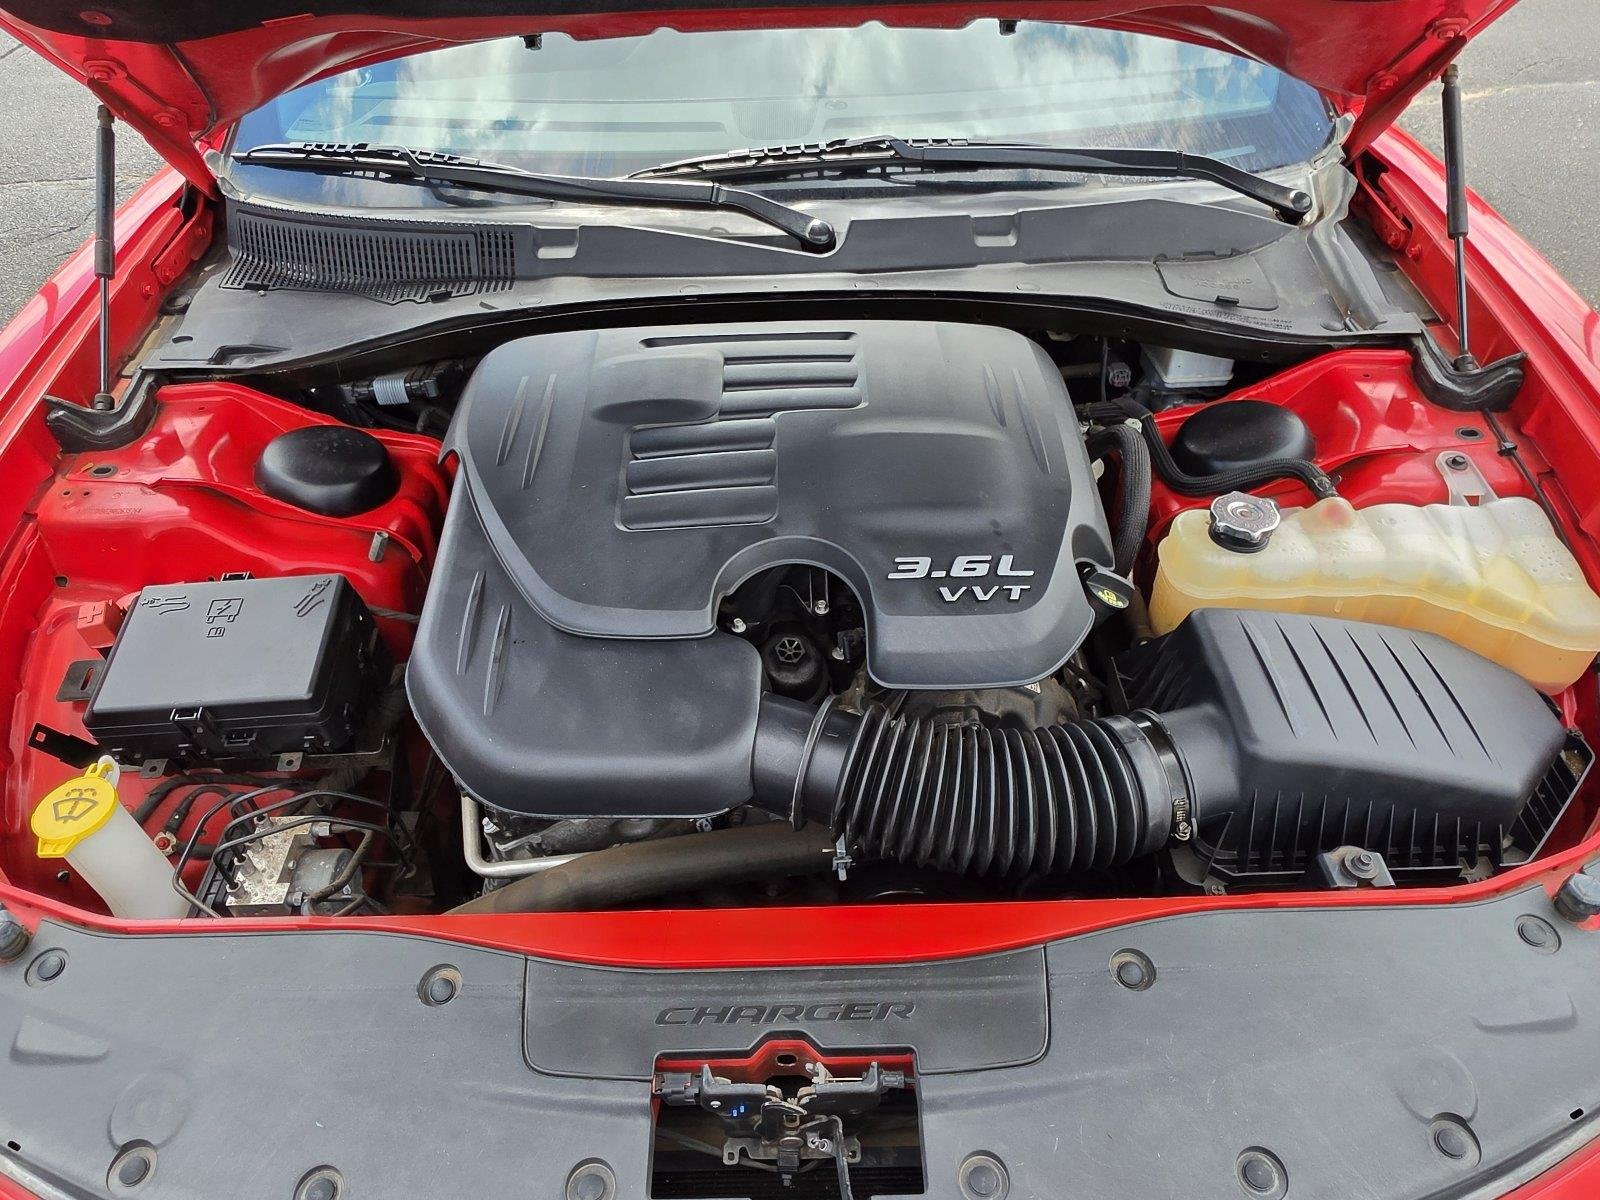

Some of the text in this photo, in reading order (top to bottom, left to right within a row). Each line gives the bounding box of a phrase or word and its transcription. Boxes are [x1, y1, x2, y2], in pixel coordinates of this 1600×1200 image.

[887, 554, 1035, 580] 3.6L
[938, 585, 1031, 602] VVT
[654, 1001, 916, 1026] CHARGER
